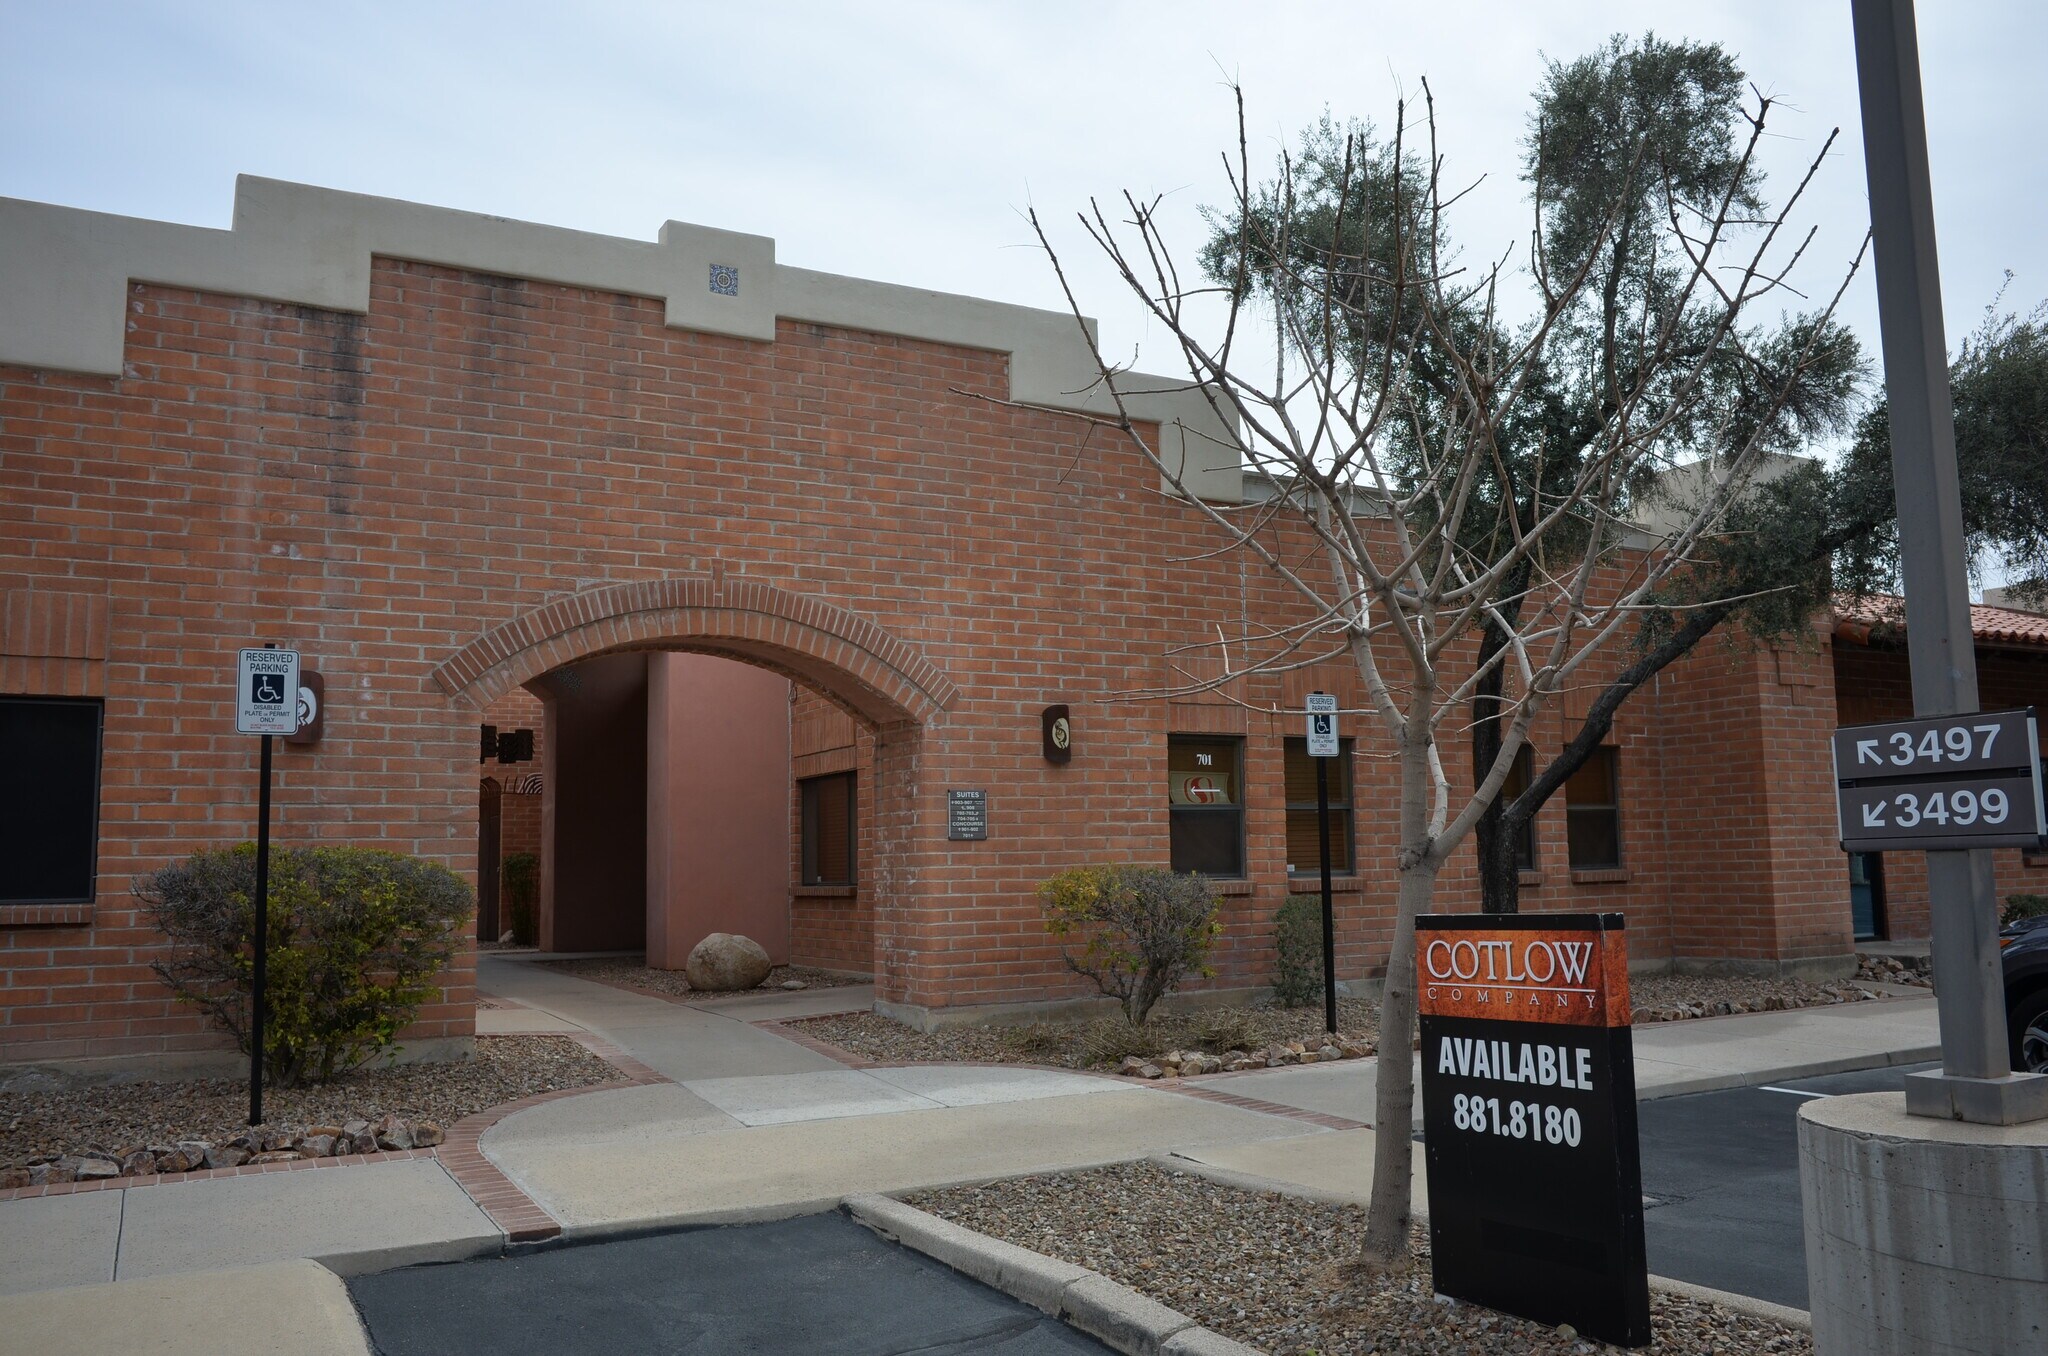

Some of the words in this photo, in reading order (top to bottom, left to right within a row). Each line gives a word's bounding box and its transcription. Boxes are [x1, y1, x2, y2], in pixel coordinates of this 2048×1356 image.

[246, 652, 293, 663] RESERVED
[249, 663, 289, 673] PARKING
[1309, 697, 1334, 706] RESERVED
[1196, 753, 1213, 766] 701
[1889, 723, 2001, 766] 3497
[1894, 788, 2009, 828] 3499
[1426, 939, 1593, 984] COTLOW
[1427, 987, 1596, 1009] COMPANY
[1438, 1036, 1593, 1091] AVAILABLE
[1453, 1093, 1582, 1148] 881.8180
